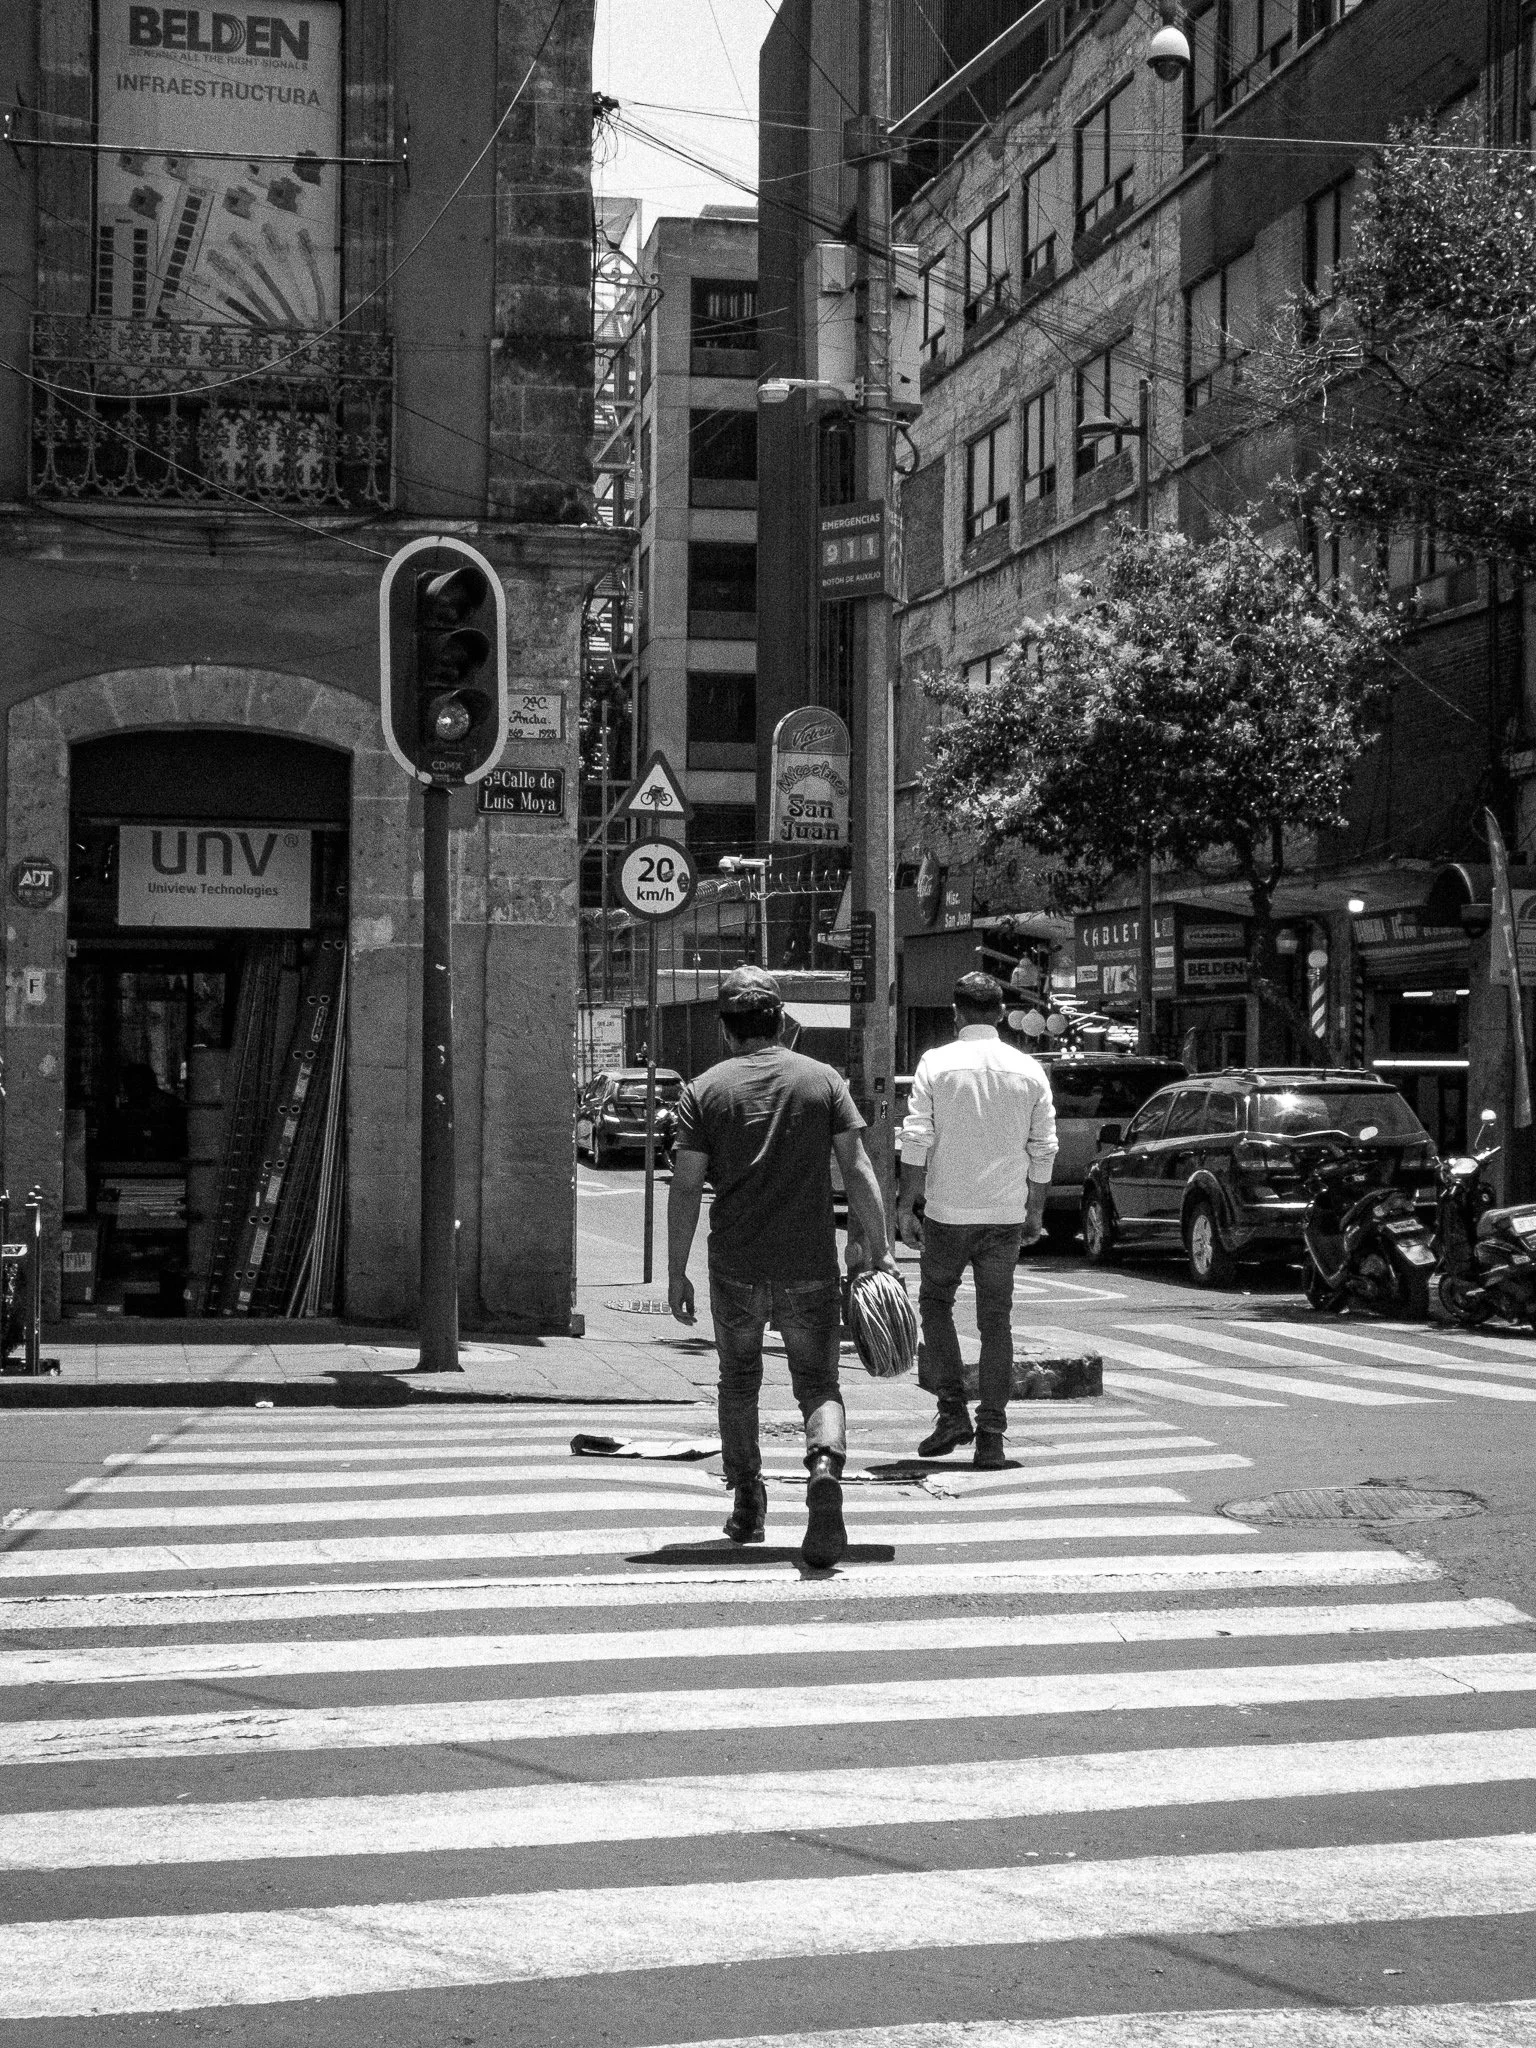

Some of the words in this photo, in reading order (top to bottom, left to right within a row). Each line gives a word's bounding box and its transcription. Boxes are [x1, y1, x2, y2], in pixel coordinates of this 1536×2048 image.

[130, 6, 309, 60] BELDEN
[116, 74, 321, 106] INFRAESTRUCTURA
[822, 513, 880, 530] EMERGENCIAS
[826, 537, 874, 563] 911
[540, 772, 555, 789] de
[484, 790, 514, 809] Luis
[521, 792, 556, 813] Moya
[788, 794, 833, 818] San
[780, 816, 840, 841] Juan
[19, 870, 53, 887] ADT
[637, 856, 675, 883] 20
[148, 882, 197, 894] Uniview
[201, 883, 279, 898] Technologies
[636, 886, 675, 902] km/h
[1187, 961, 1244, 976] BELDEN
[29, 978, 40, 994] F
